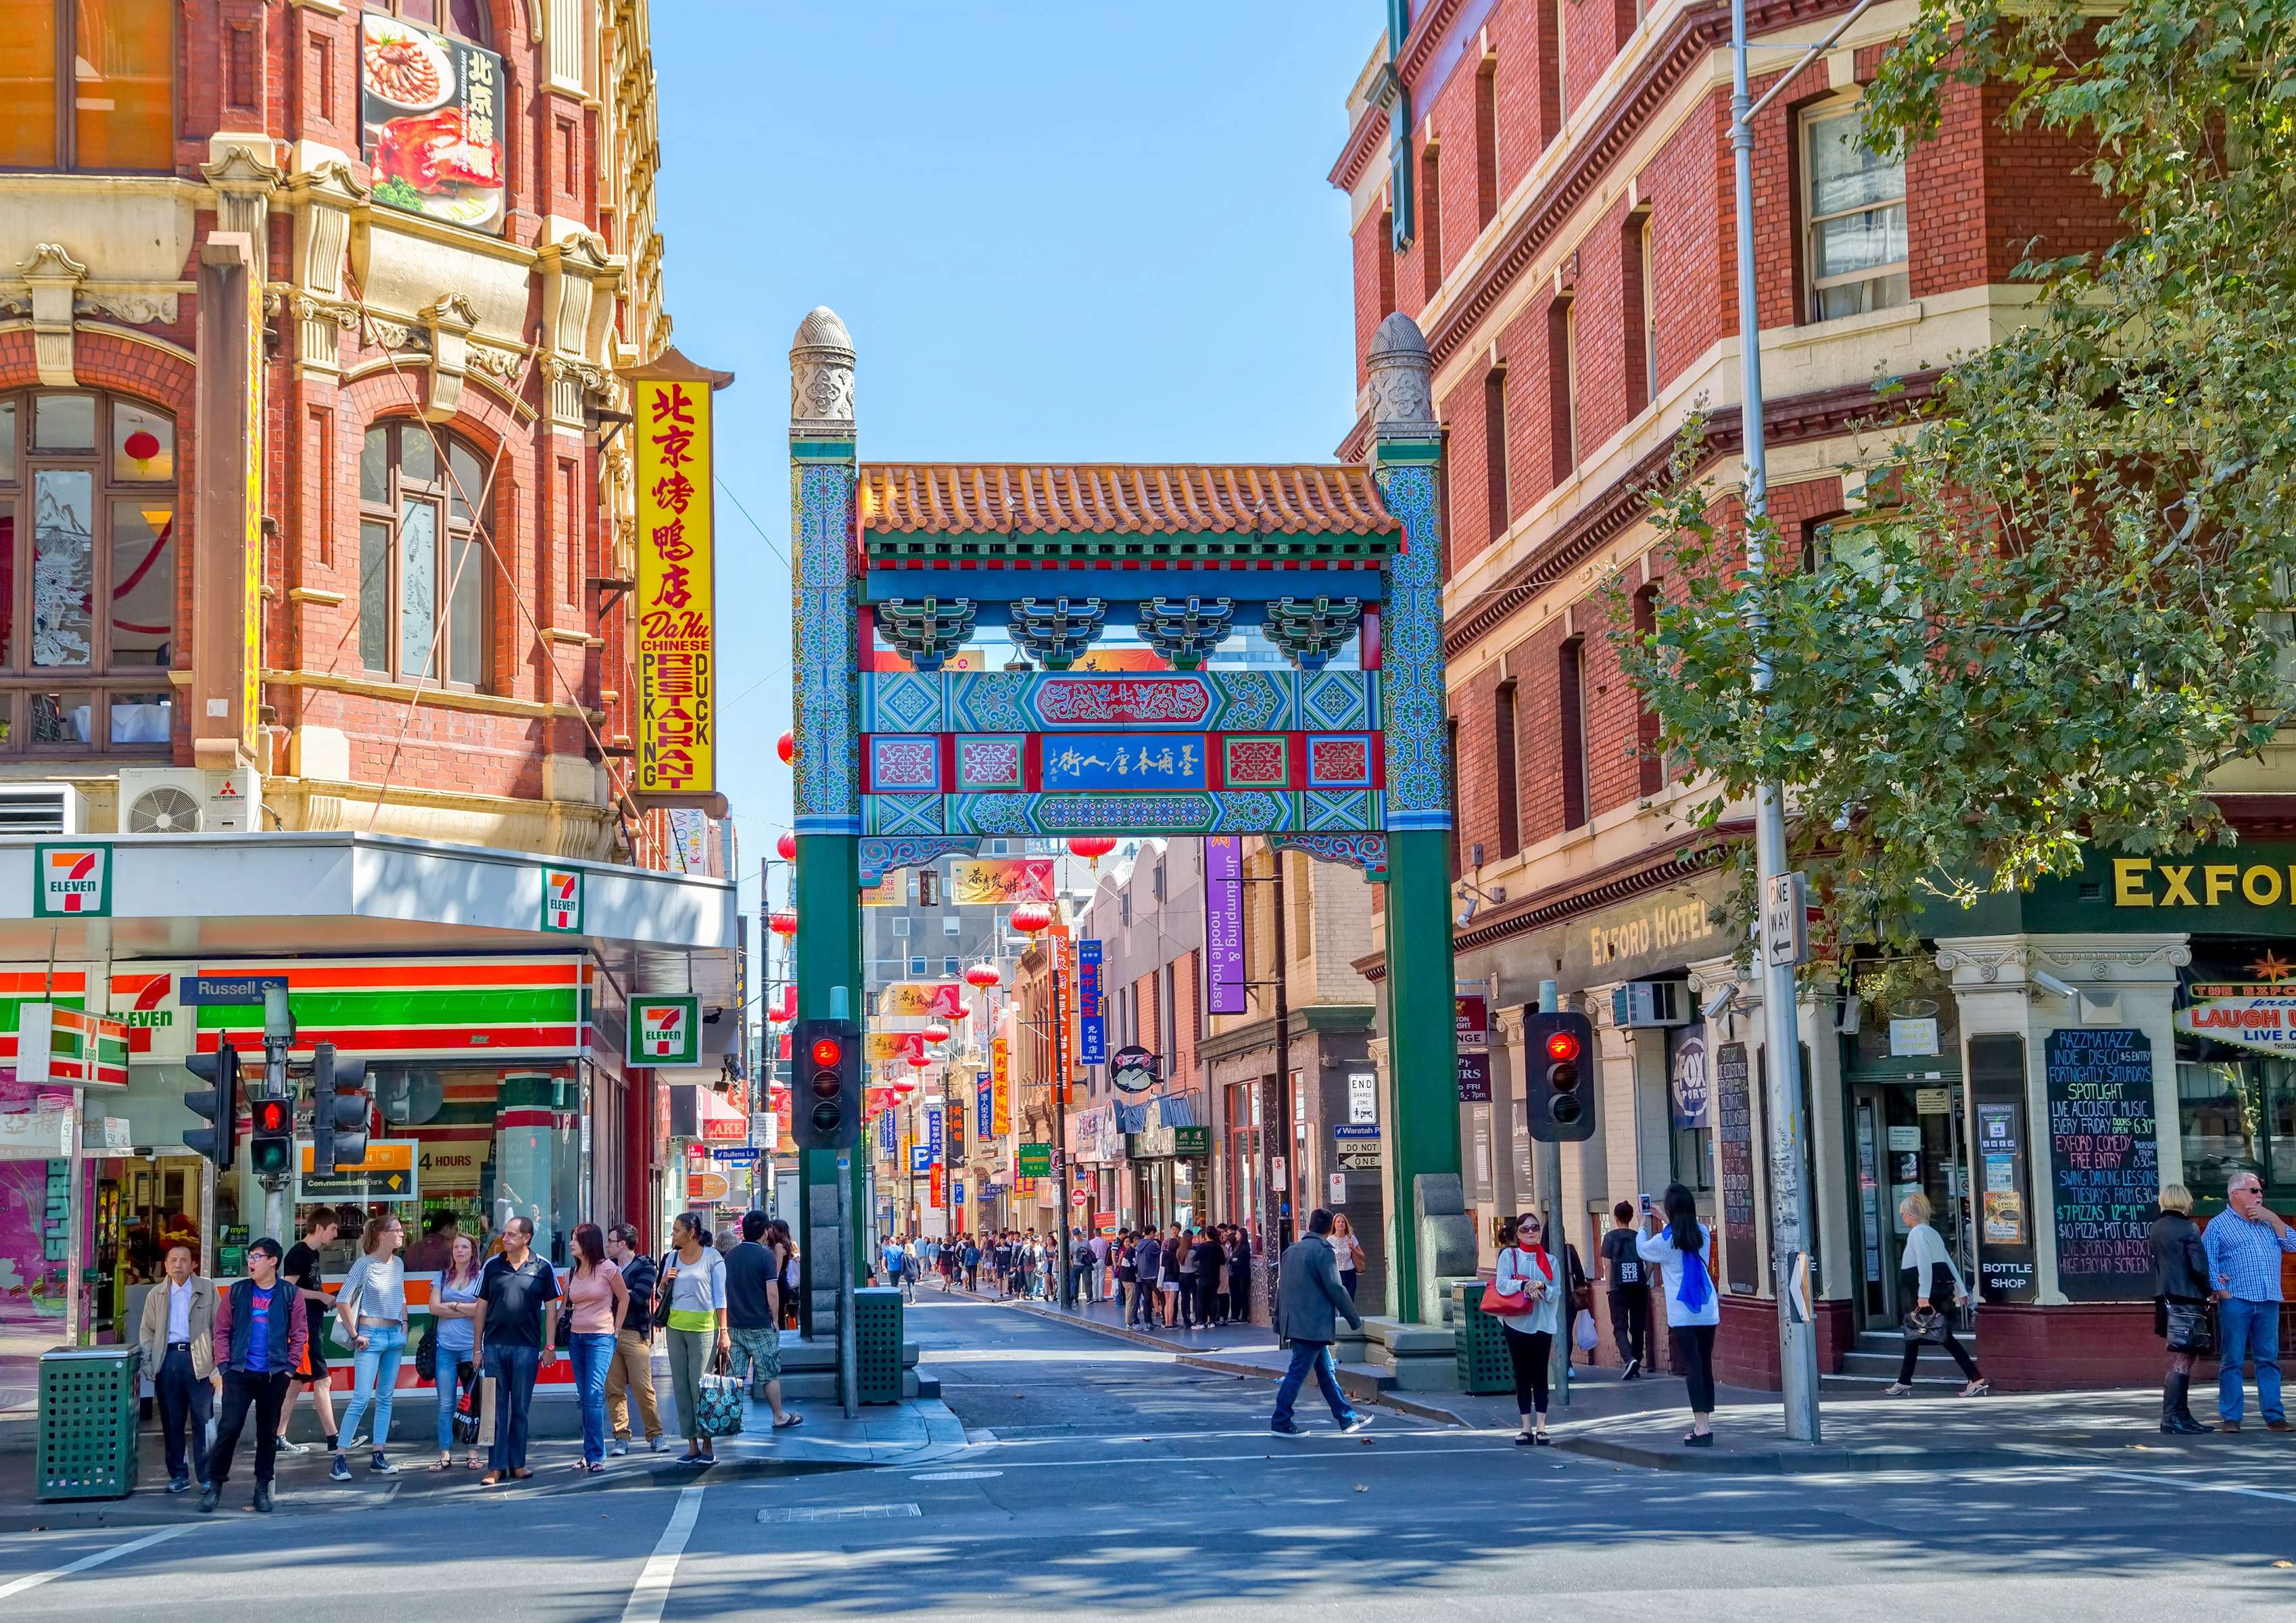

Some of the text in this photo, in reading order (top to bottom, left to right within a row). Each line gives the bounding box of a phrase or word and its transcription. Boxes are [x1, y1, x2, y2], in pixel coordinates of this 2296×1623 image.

[651, 383, 695, 609] 北京烤鴨店
[641, 640, 709, 651] CHINESE
[696, 653, 709, 745] DUCK
[643, 653, 656, 786] PEKING
[657, 653, 694, 789] RESTAURANT
[2112, 856, 2296, 908] EXFO
[1770, 883, 1788, 905] ONE
[1225, 855, 1241, 962] Jin dumpling &
[1770, 910, 1790, 933] WAY
[1211, 910, 1224, 1008] noodle house
[198, 981, 256, 995] Russell
[2195, 986, 2234, 996] THE
[2191, 1009, 2281, 1028] LAUGH
[2059, 1032, 2134, 1048] RAZZMATAZZ
[2244, 1030, 2282, 1041] LIVE
[2055, 1050, 2080, 1065] INDIE
[2089, 1050, 2119, 1065] DISCO
[2132, 1051, 2151, 1062] ENTRY
[2107, 1066, 2153, 1082] SATURDAYS
[1352, 1080, 1372, 1089] END
[2067, 1083, 2124, 1100] SPOTLIGHT
[2052, 1101, 2070, 1116] LIVE
[2121, 1101, 2148, 1116] MUSIC
[704, 1123, 742, 1134] LAKE
[2053, 1118, 2112, 1134] EVERY FRIDAY
[1361, 1144, 1377, 1152] NOT
[2056, 1135, 2132, 1152] EXFORD COMEDY
[435, 1155, 471, 1167] HOURS
[914, 1149, 929, 1168] P
[2071, 1152, 2122, 1169] FREE ENTRY
[2059, 1170, 2087, 1186] SWING
[2122, 1170, 2159, 1186] LESSONS
[2070, 1187, 2111, 1204] TUESDAYS
[2072, 1204, 2105, 1221] PIZZAS
[2075, 1222, 2098, 1239] PIZZA
[2104, 1222, 2121, 1239] POT
[1621, 1263, 1637, 1271] SPR
[1982, 1263, 2033, 1273] BOTTLE
[1991, 1279, 2026, 1288] SHOP
